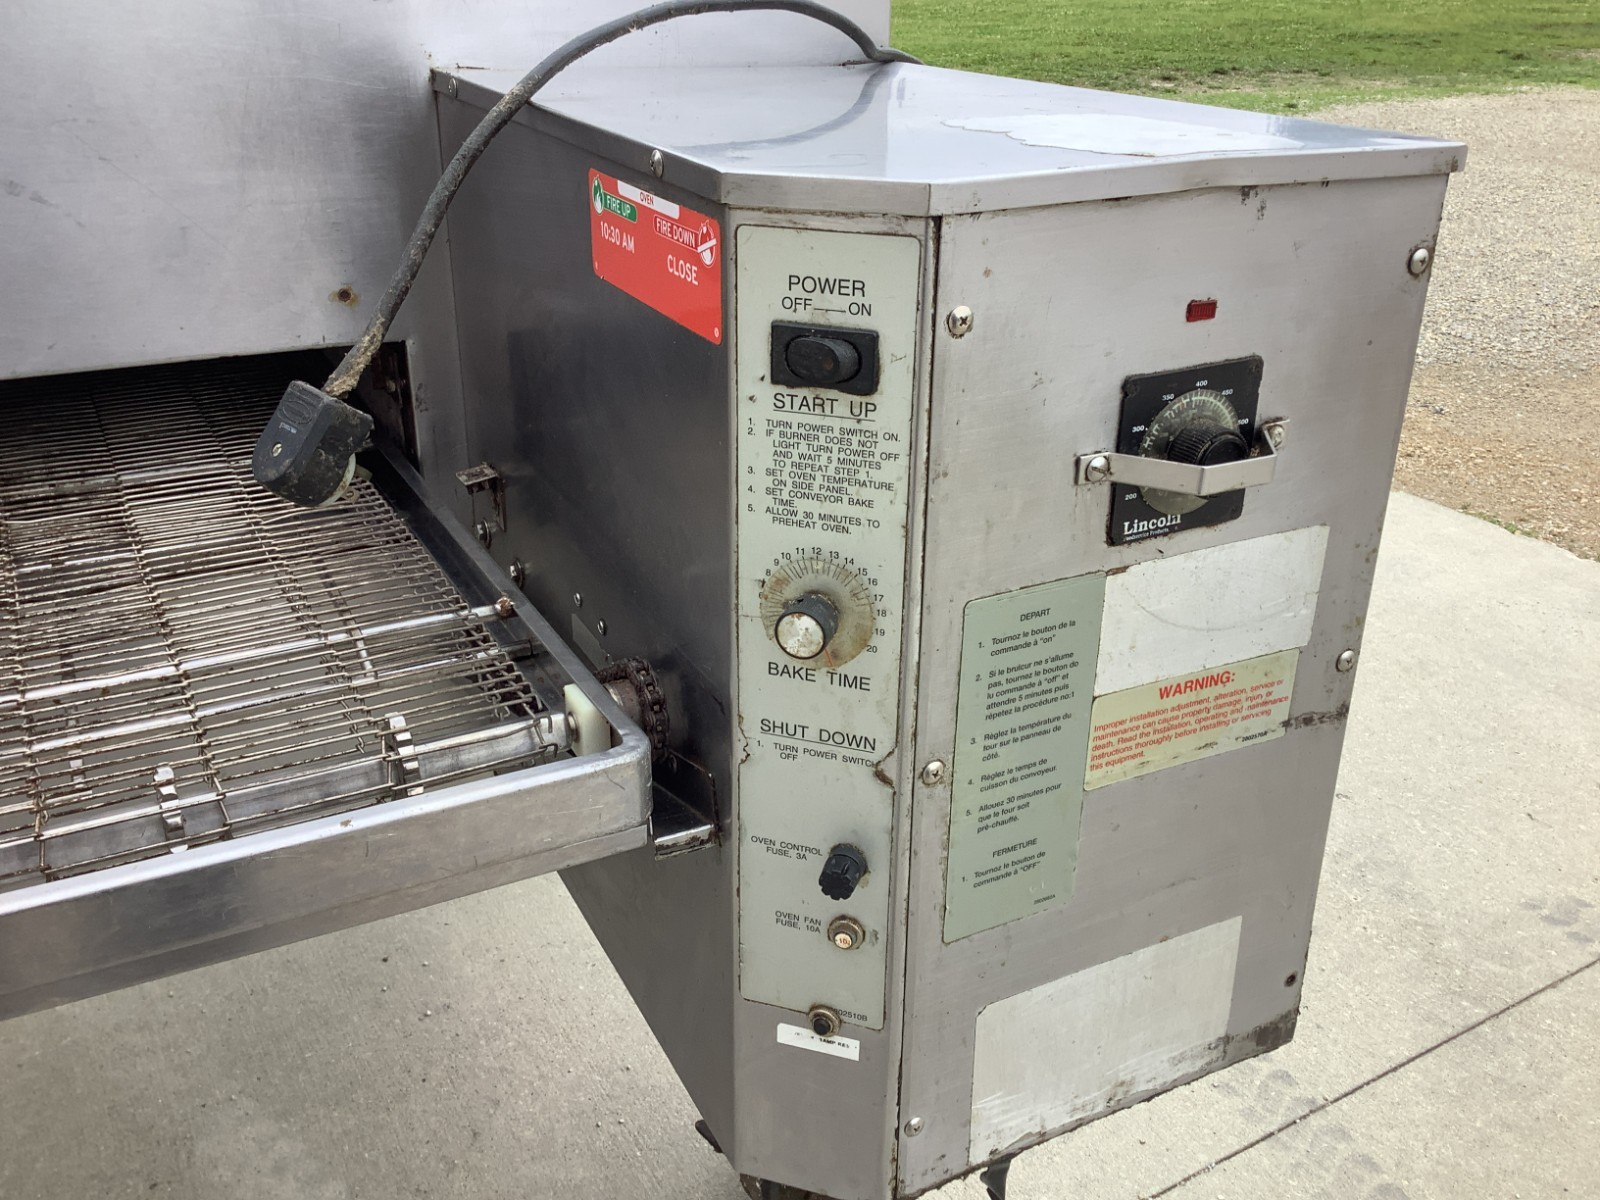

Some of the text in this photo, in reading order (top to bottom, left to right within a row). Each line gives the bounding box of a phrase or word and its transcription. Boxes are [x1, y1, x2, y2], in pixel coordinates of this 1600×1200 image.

[606, 196, 631, 217] FIRE UP
[640, 192, 654, 206] OVEN
[600, 222, 635, 254] 10:30 AM
[656, 218, 695, 248] FIRE DOWN
[667, 254, 698, 285] CLOSE
[789, 275, 865, 297] POWER
[782, 297, 871, 316] OFF ON
[773, 393, 877, 418] START UP
[748, 418, 900, 442] 1. TURN POWER SWITCH ON.
[779, 431, 819, 442] BURNER
[825, 436, 852, 446] DOES
[858, 440, 879, 449] NOT
[773, 440, 900, 462] LIGHT TURN POWER OFF
[773, 450, 881, 470] AND WAIT 5 MINUTES
[773, 460, 873, 479] TO REPEAT STEP 1.
[766, 468, 783, 477] SET
[789, 471, 816, 481] OVEN
[821, 475, 894, 491] TEMPERATURE
[772, 479, 853, 496] ON SIDE PANEL.
[748, 485, 874, 508] 4. SET CONVEYOR BAKE
[772, 498, 797, 508] TIME.
[748, 504, 880, 528] 5. ALLOW 30 MINUTES TO
[772, 517, 851, 534] PREHEAT OVEN.
[781, 552, 791, 560] 10
[812, 547, 822, 555] 12
[829, 551, 839, 559] 13
[844, 557, 854, 565] 14
[857, 568, 867, 576] 15
[868, 578, 878, 586] 16
[874, 594, 884, 602] 17
[1020, 608, 1051, 621] DEPART
[1031, 624, 1056, 636] bouton
[991, 641, 1031, 656] commande
[768, 662, 870, 691] BAKE TIME
[1006, 673, 1032, 684] tournez
[1043, 664, 1067, 675] bouton
[996, 682, 1036, 697] commande
[1159, 671, 1235, 699] WARNING:
[986, 683, 1069, 710] attendre minutes puis
[1094, 718, 1127, 732] Improper
[1129, 708, 1168, 723] installation
[1251, 680, 1275, 692] service
[1093, 725, 1140, 742] maintenance
[1142, 720, 1156, 729] can
[1158, 714, 1179, 725] cause
[1118, 734, 1137, 745] Read
[1195, 711, 1228, 724] operating
[1230, 705, 1243, 715] and
[760, 719, 876, 751] SHUT DOWN
[1020, 729, 1050, 742] panneau
[1091, 745, 1132, 761] instructions
[1135, 735, 1172, 749] thoroughly
[1174, 727, 1197, 739] before
[1200, 720, 1230, 732] installing
[774, 743, 798, 753] TURN
[804, 748, 837, 760] POWER
[780, 752, 798, 761] OFF
[1015, 761, 1036, 772] temps
[1090, 763, 1103, 771] this
[980, 780, 1007, 792] cuisson
[979, 784, 1062, 812] Allouez 30 minutes pour
[978, 802, 1030, 823] que four soit
[751, 836, 822, 856] OVEN CONTROL
[993, 838, 1037, 858] FERMETURE
[796, 852, 807, 861] 3A
[1011, 855, 1035, 867] bouton
[973, 872, 1012, 888] commande
[775, 911, 821, 926] OVEN FAN
[806, 925, 821, 934] 10A
